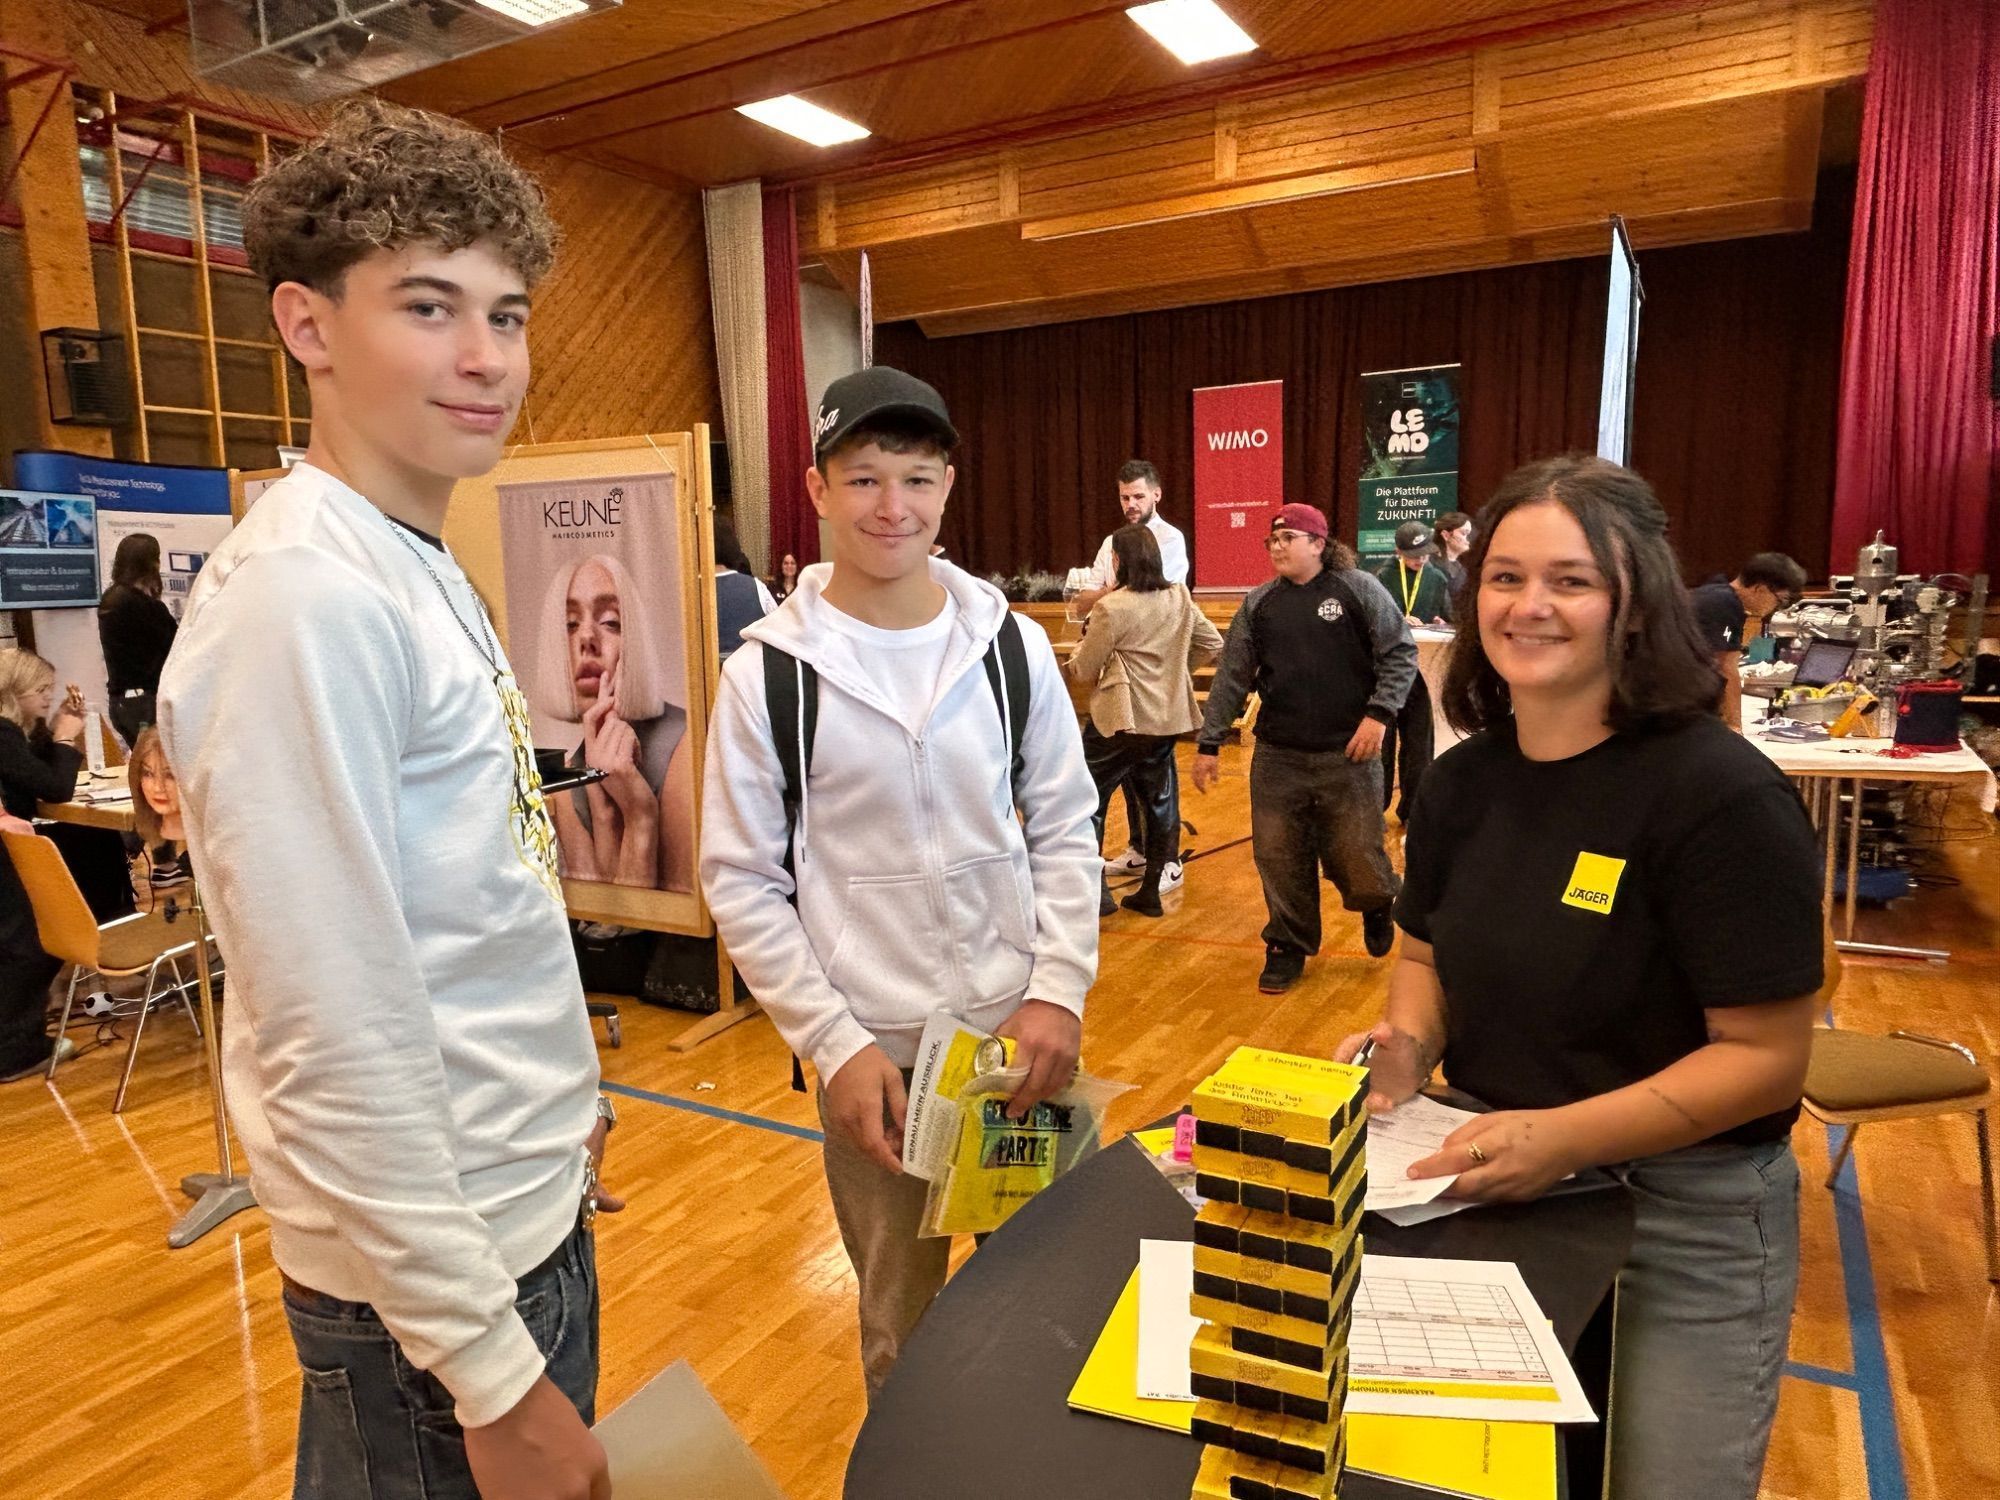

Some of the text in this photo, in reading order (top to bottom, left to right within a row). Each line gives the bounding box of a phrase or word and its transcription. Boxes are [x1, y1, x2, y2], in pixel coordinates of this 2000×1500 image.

[1390, 407, 1425, 433] LE
[1207, 428, 1269, 450] WIMO
[1387, 431, 1430, 453] MO
[1375, 485, 1439, 497] Die Plattform
[1385, 497, 1429, 508] für Deine
[543, 498, 621, 528] KEUNE
[1377, 509, 1437, 521] ZUKUNFT!
[552, 530, 615, 539] HAIRCOSMETICS
[1568, 886, 1609, 905] JÄGER
